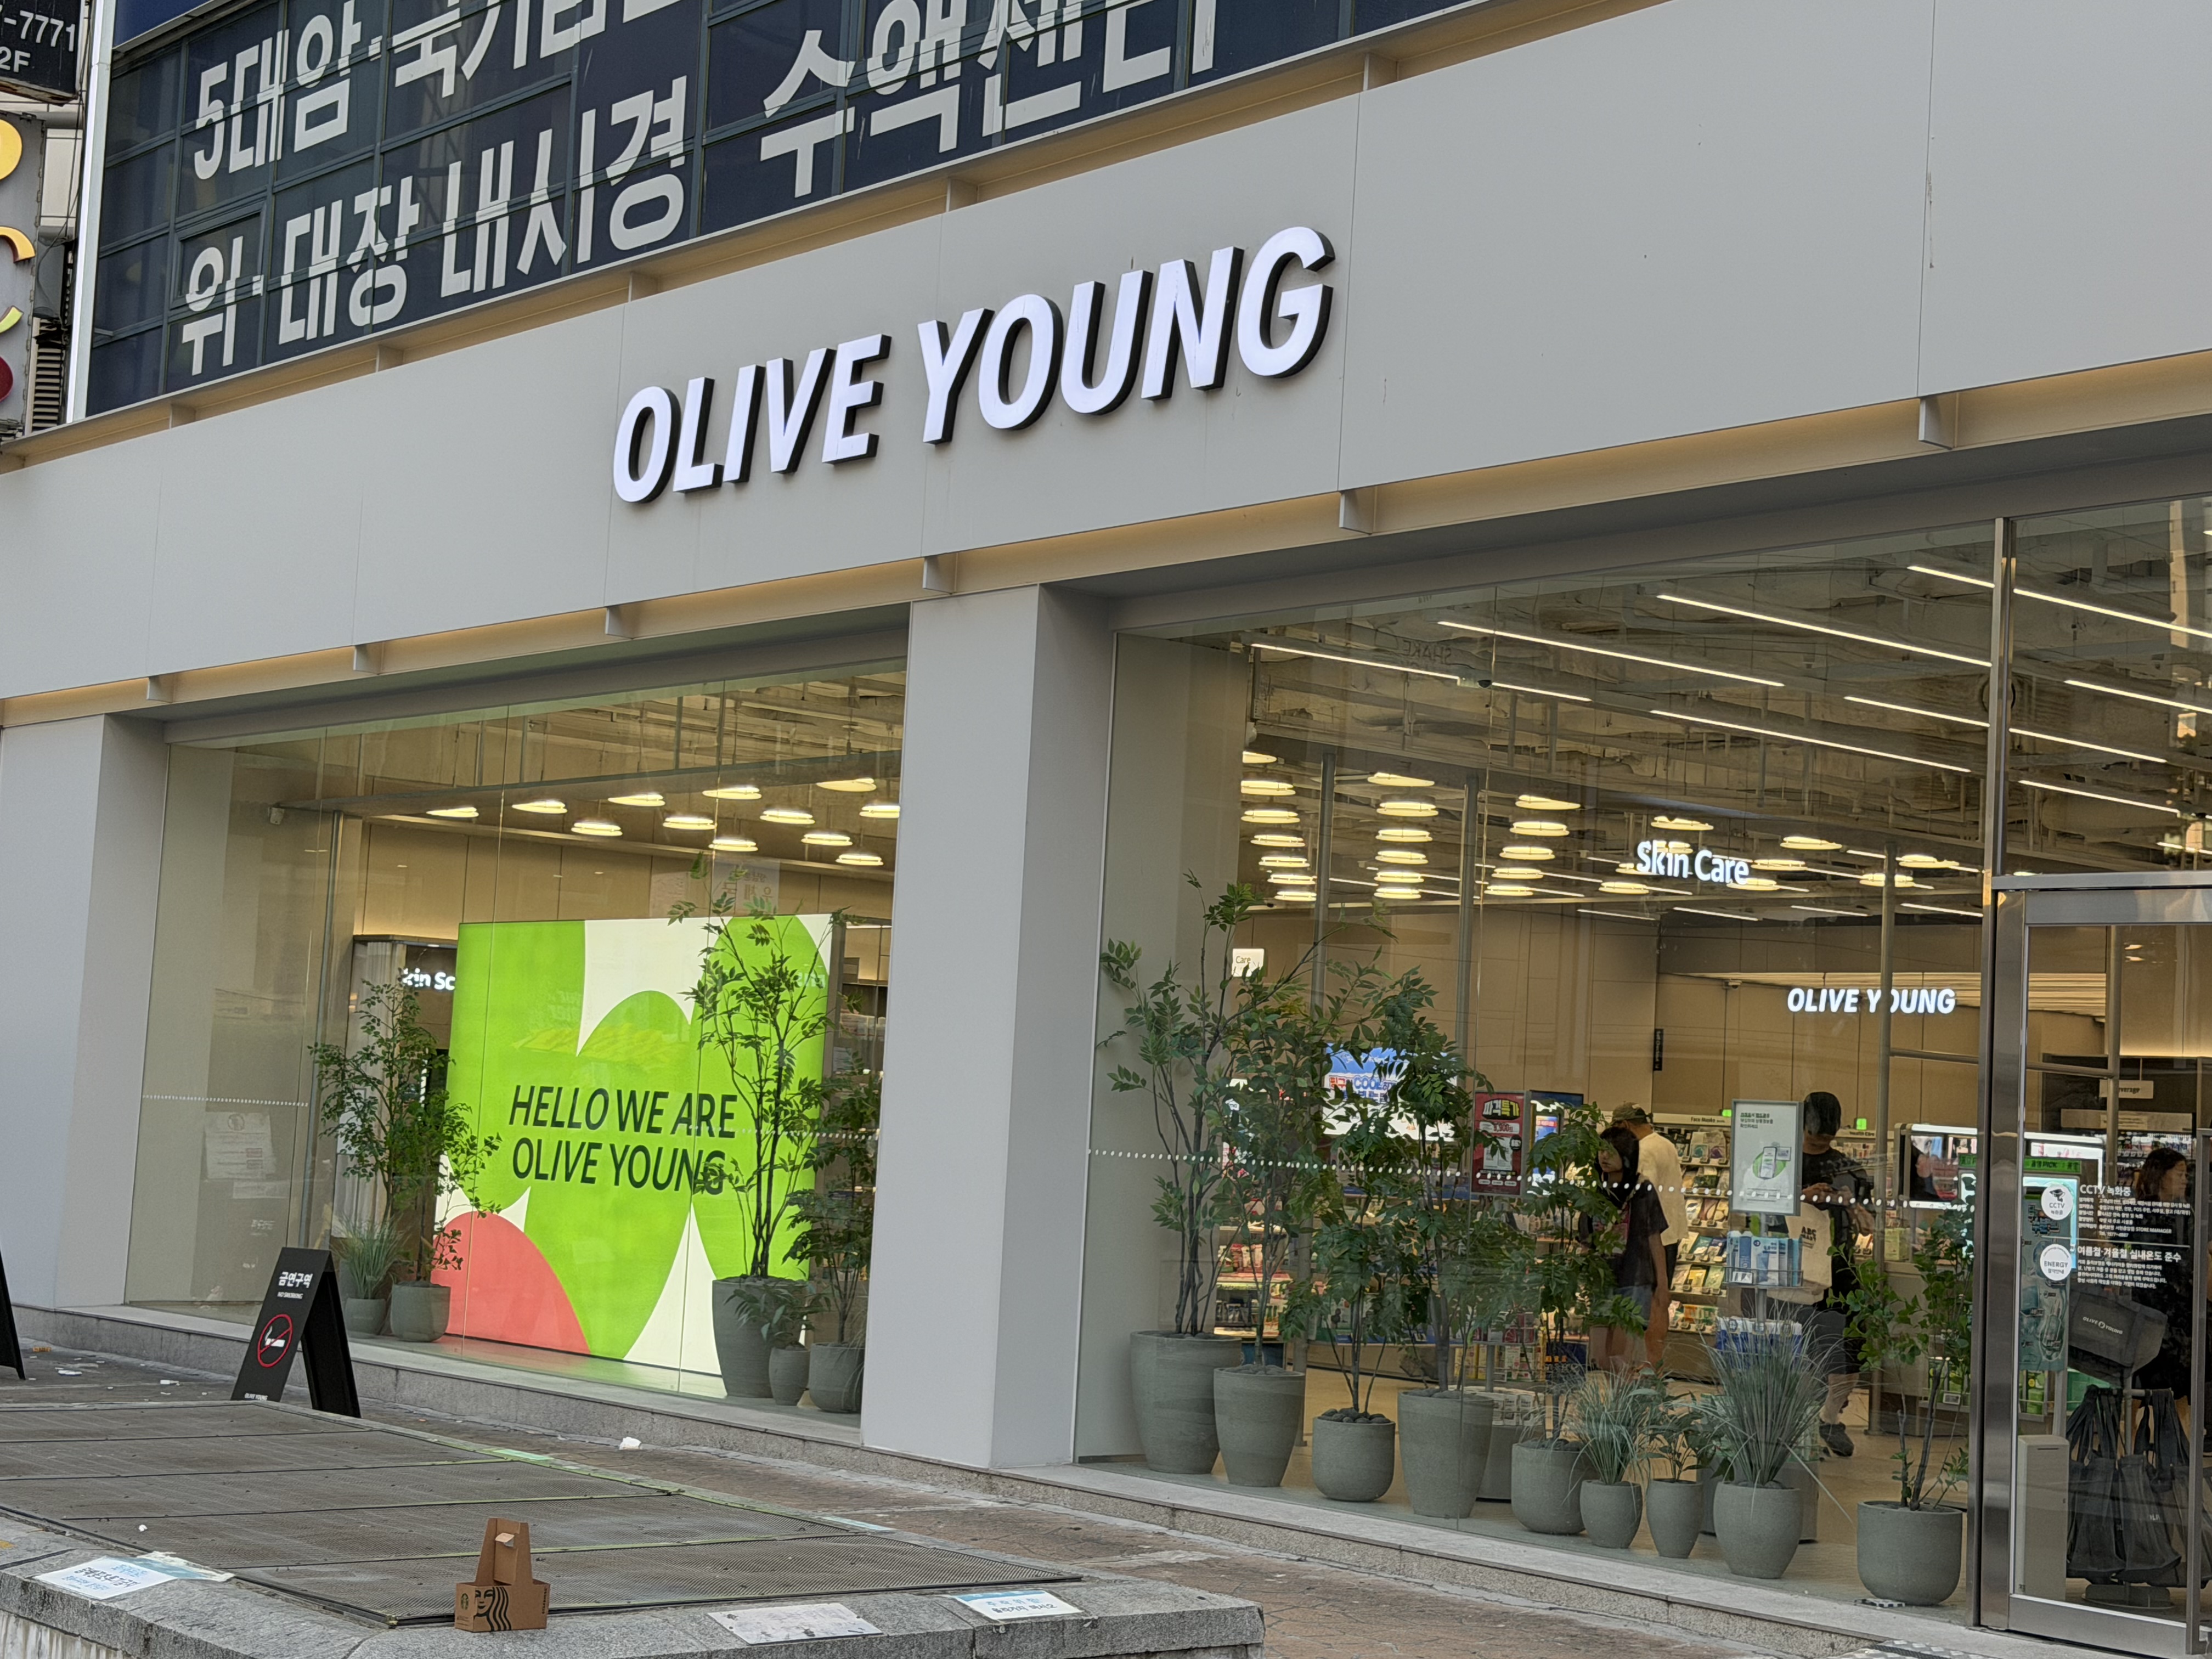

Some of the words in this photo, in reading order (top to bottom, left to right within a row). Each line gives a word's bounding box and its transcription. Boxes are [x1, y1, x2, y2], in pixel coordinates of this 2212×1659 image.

[0, 4, 76, 52] -7771
[0, 46, 31, 72] 2F
[441, 75, 687, 298] 내시경
[613, 333, 891, 503] OLIVE
[918, 226, 1335, 445] YOUNG
[1637, 840, 1689, 878] Skin
[1695, 849, 1750, 885] Care
[1235, 956, 1251, 964] Care
[402, 968, 431, 988] kin
[1787, 988, 1859, 1013] OLIVE
[509, 1085, 609, 1131] HELLO
[617, 1089, 669, 1134] WE
[670, 1093, 737, 1138] ARE
[1483, 1099, 1520, 1116] 파격특가
[513, 1137, 602, 1184] OLIVE
[609, 1143, 726, 1195] YOUNG
[2080, 1184, 2106, 1194] CCTV
[2107, 1186, 2131, 1197] 녹화중
[2130, 1249, 2163, 1261] 실내온도
[2164, 1251, 2182, 1262] 준수
[278, 1271, 313, 1288] 금연구역
[2083, 1317, 2098, 1325] OLIVE
